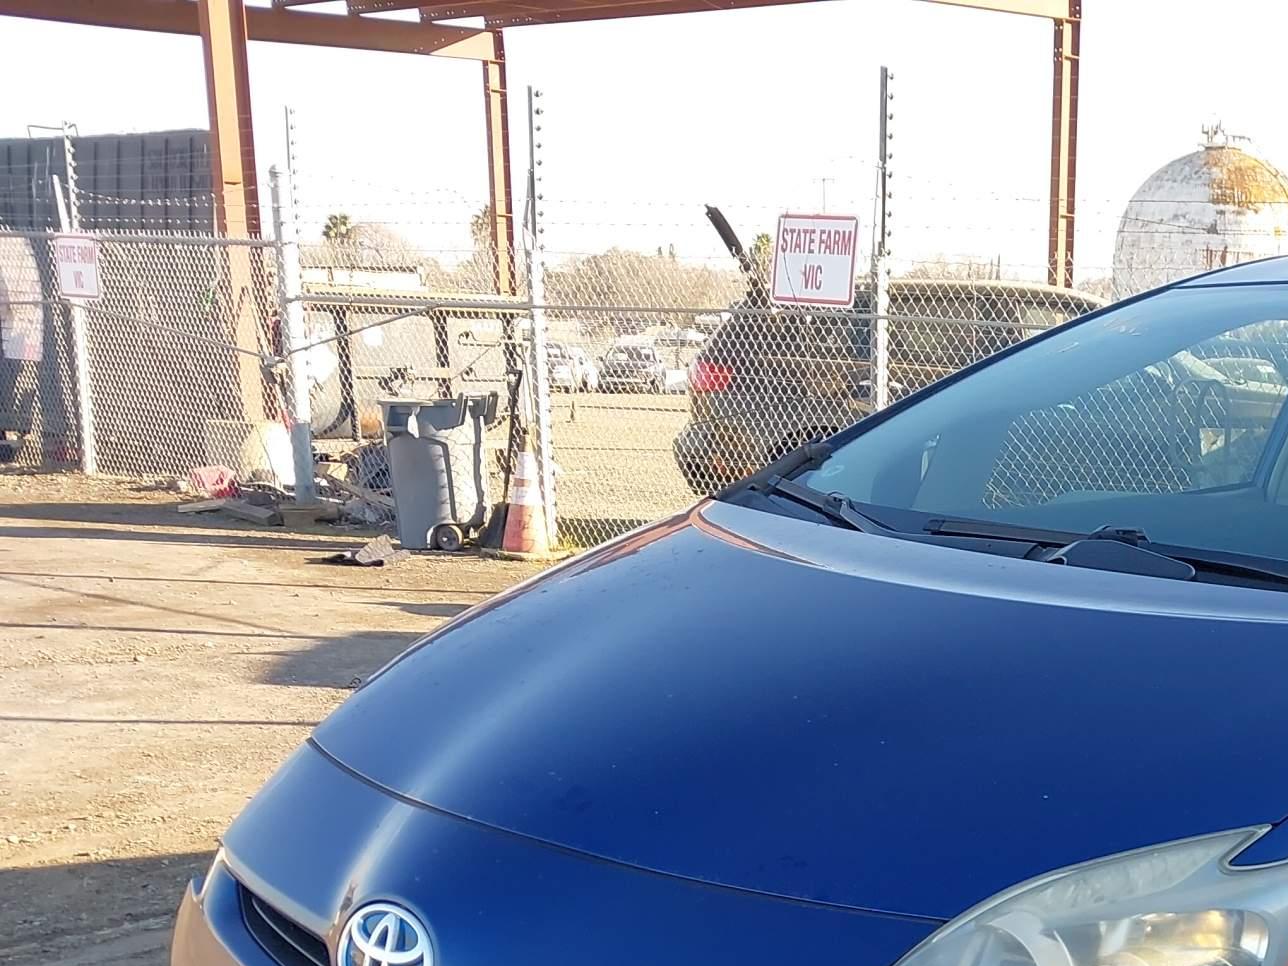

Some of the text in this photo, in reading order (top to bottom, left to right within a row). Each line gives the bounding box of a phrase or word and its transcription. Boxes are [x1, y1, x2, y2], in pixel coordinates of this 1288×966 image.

[58, 245, 76, 263] STATE
[780, 227, 852, 256] STATE FARM
[803, 263, 823, 290] VIC
